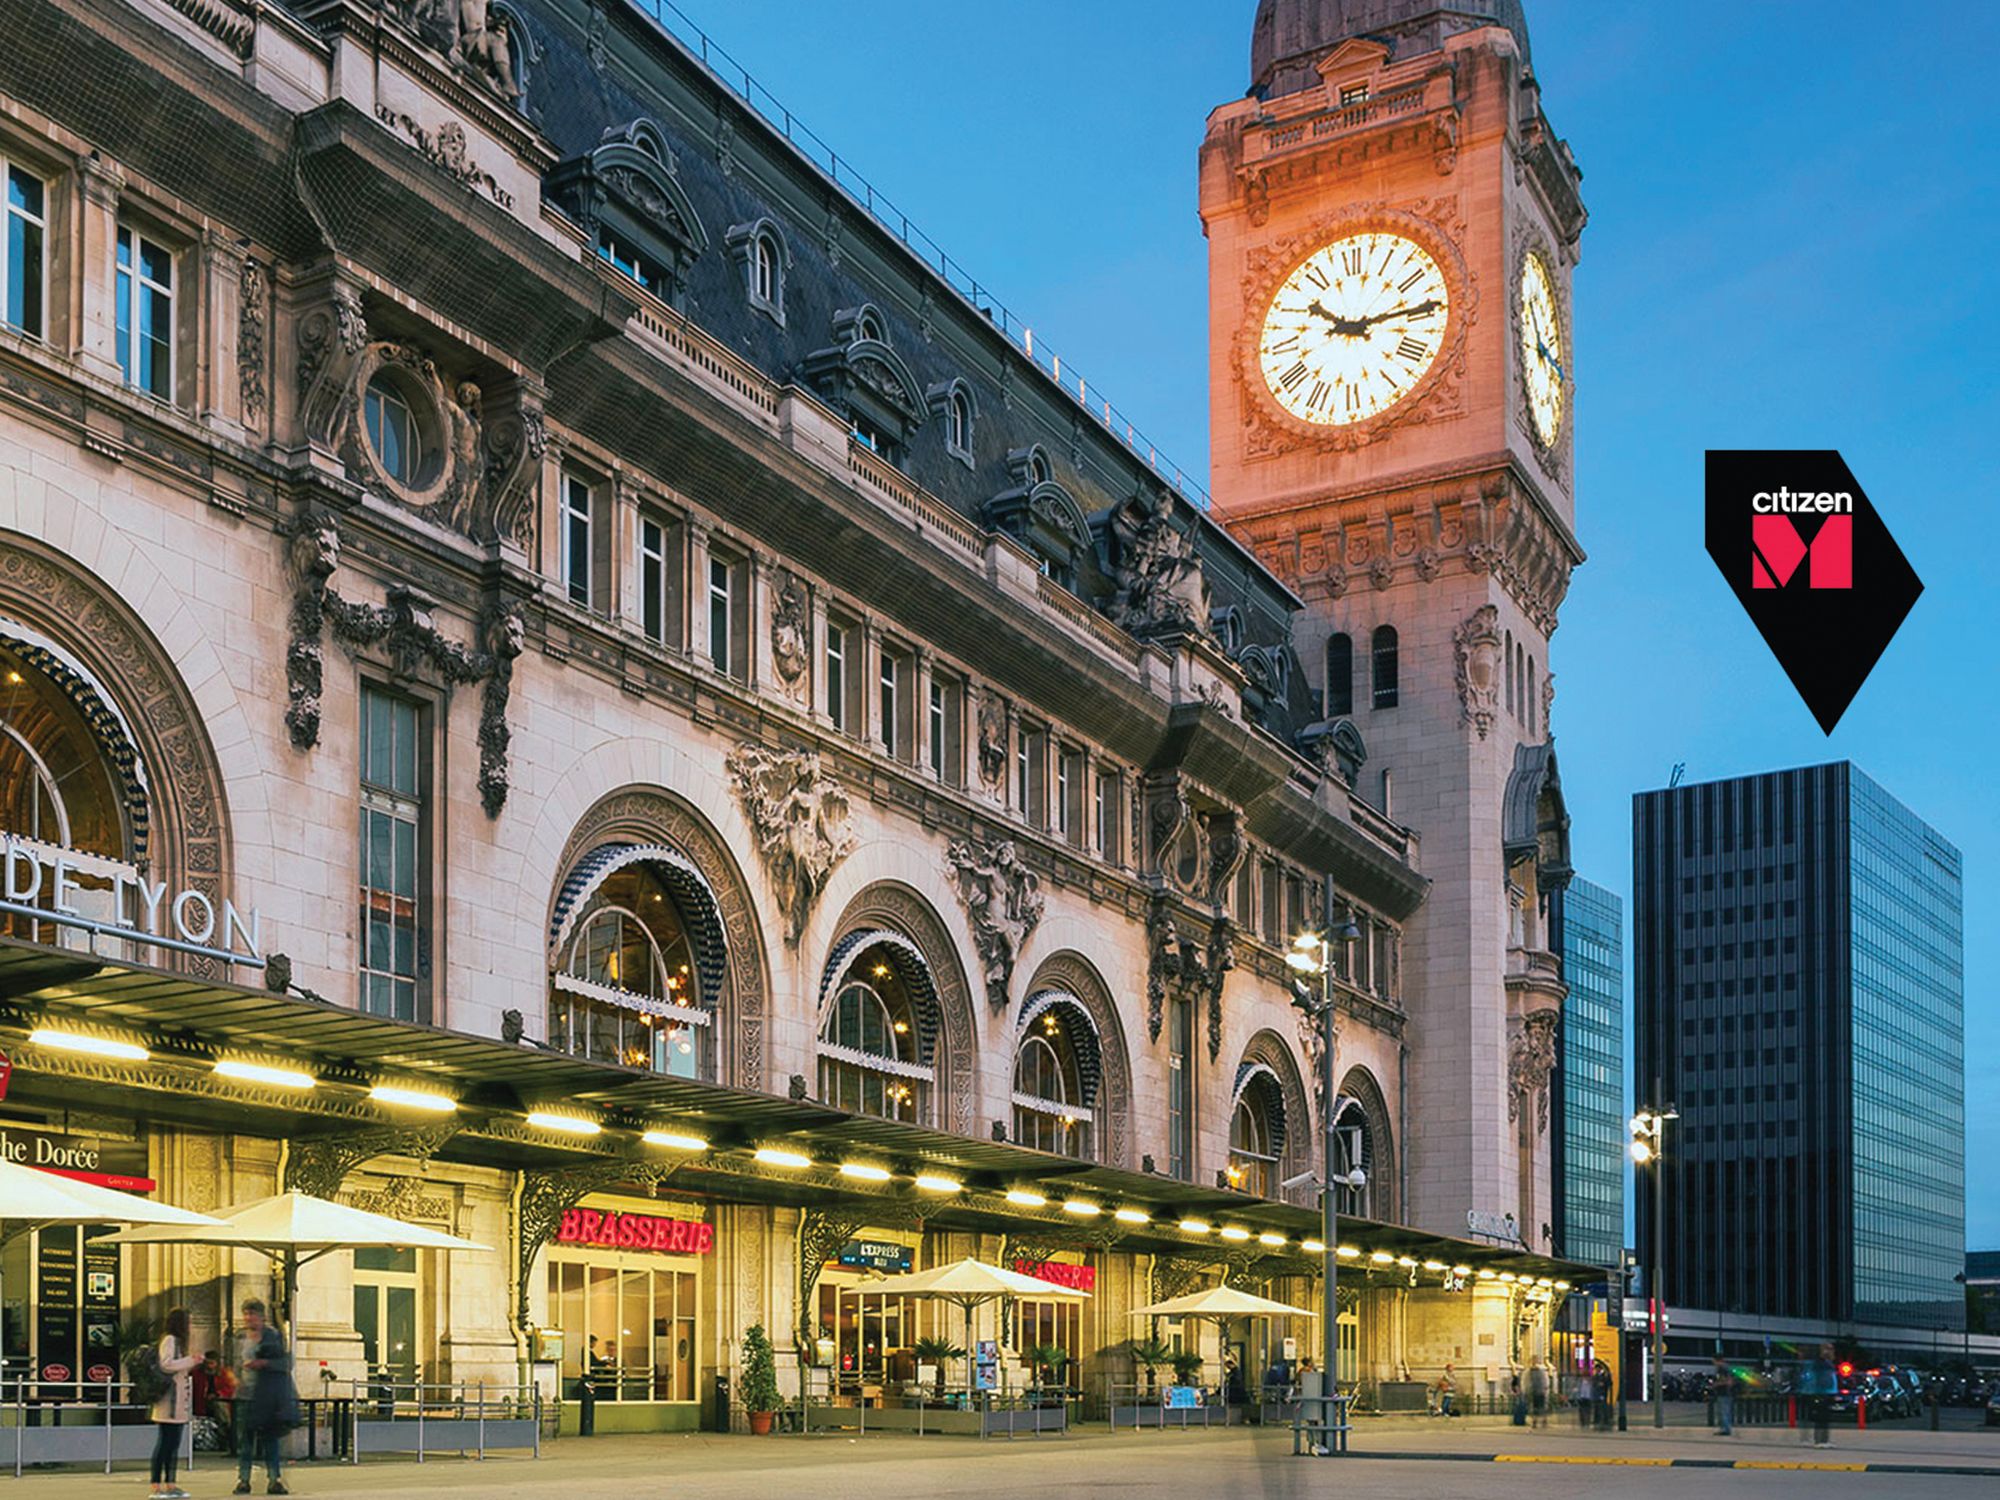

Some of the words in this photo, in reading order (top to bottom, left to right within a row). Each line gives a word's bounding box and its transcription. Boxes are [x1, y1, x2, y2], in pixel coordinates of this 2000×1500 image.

[5, 842, 80, 915] DE
[114, 871, 265, 959] LYON
[0, 1132, 27, 1162] he
[36, 1137, 99, 1169] Dorée
[559, 1208, 714, 1254] BRASSERIE
